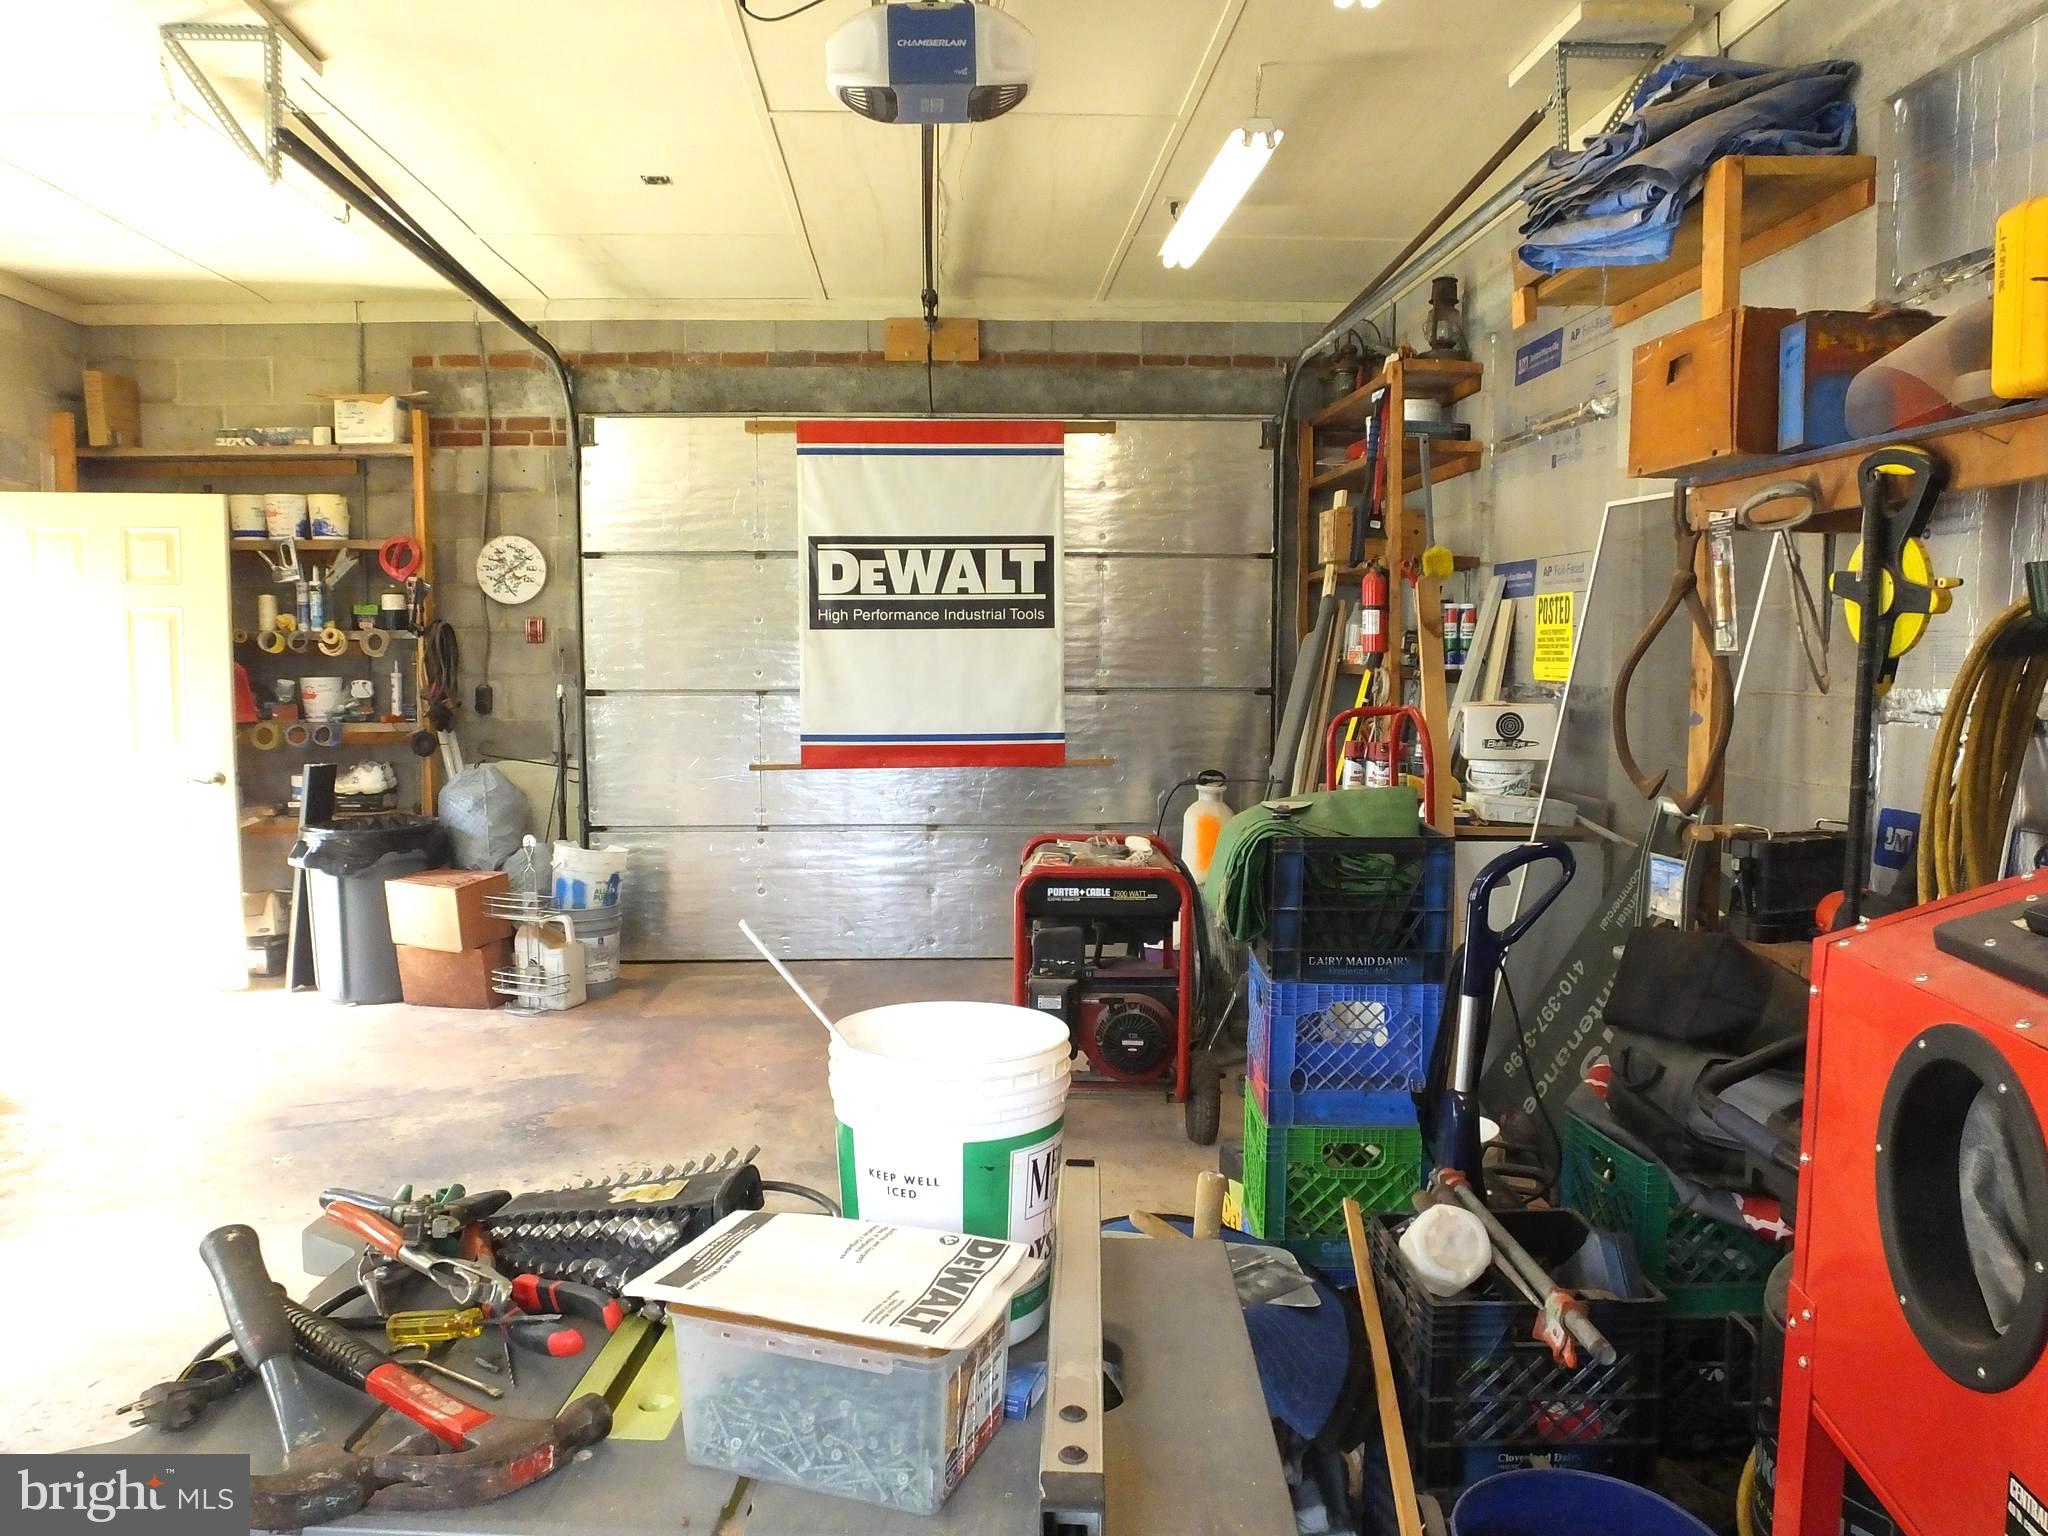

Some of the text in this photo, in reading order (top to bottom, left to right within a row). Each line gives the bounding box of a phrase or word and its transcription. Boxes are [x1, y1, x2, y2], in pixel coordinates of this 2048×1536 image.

[896, 39, 967, 48] CHAMBERLAIN
[817, 549, 1046, 595] DEWALT
[1543, 566, 1553, 577] AP
[817, 607, 1045, 624] High Performance Industrial Tools
[1538, 596, 1571, 625] POSTED
[1883, 826, 1913, 852] JM
[1113, 890, 1128, 898] 7500
[1129, 890, 1147, 898] WATT
[1308, 956, 1343, 966] DAIRY
[1346, 956, 1375, 966] MAID
[868, 1168, 941, 1188] KEEP WELL
[886, 1186, 918, 1200] ICED
[897, 1238, 1008, 1335] DEWALT
